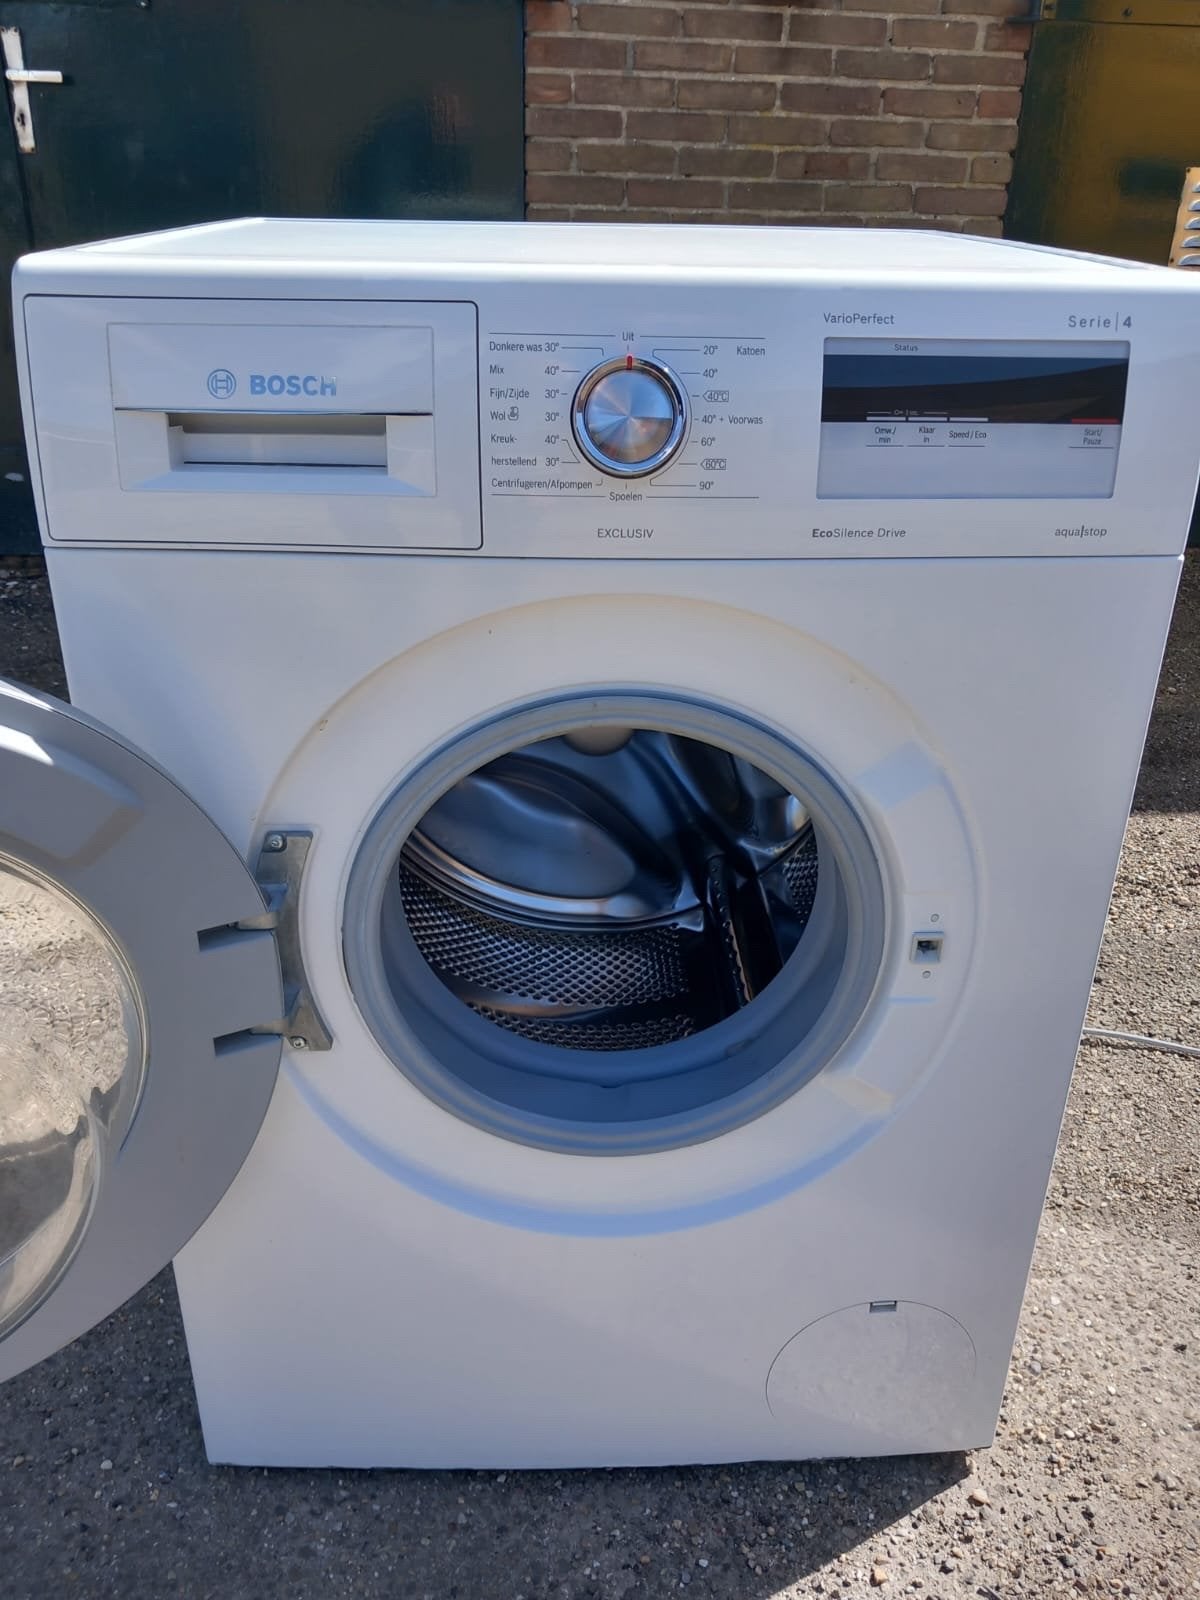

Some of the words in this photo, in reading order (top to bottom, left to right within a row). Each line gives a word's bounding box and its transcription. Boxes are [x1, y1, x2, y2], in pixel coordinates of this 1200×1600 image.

[823, 313, 895, 325] VarioPerfect
[622, 331, 635, 342] Uit
[489, 341, 524, 352] Donkere
[526, 344, 543, 353] was
[545, 342, 560, 352] 30°
[703, 345, 719, 355] 20°
[736, 346, 766, 356] Katoen
[894, 343, 919, 352] Status
[489, 365, 505, 375] Mix
[544, 366, 560, 376] 40°
[702, 368, 718, 378] 40°
[250, 374, 337, 397] BOSCH
[489, 388, 530, 399] Fijn/Zijde
[545, 389, 560, 399] 30°
[490, 411, 506, 421] Wol
[545, 412, 560, 422] 30°
[701, 414, 717, 424] 40°
[728, 415, 764, 425] Voorwas
[918, 426, 936, 434] Klaar
[948, 430, 969, 440] Speed
[975, 430, 987, 439] Eco
[490, 434, 518, 444] Kreuk-
[544, 435, 560, 444] 40°
[700, 437, 716, 446] 60°
[923, 436, 930, 444] in
[491, 456, 537, 467] herstellend
[545, 457, 560, 467] 30°
[491, 479, 593, 490] Centrifugeren/Afpompen
[699, 480, 714, 490] 90°
[609, 491, 643, 502] Spoelen
[597, 528, 654, 539] EXCLUSIV
[812, 528, 874, 539] EcoSilence
[877, 528, 907, 538] Drive
